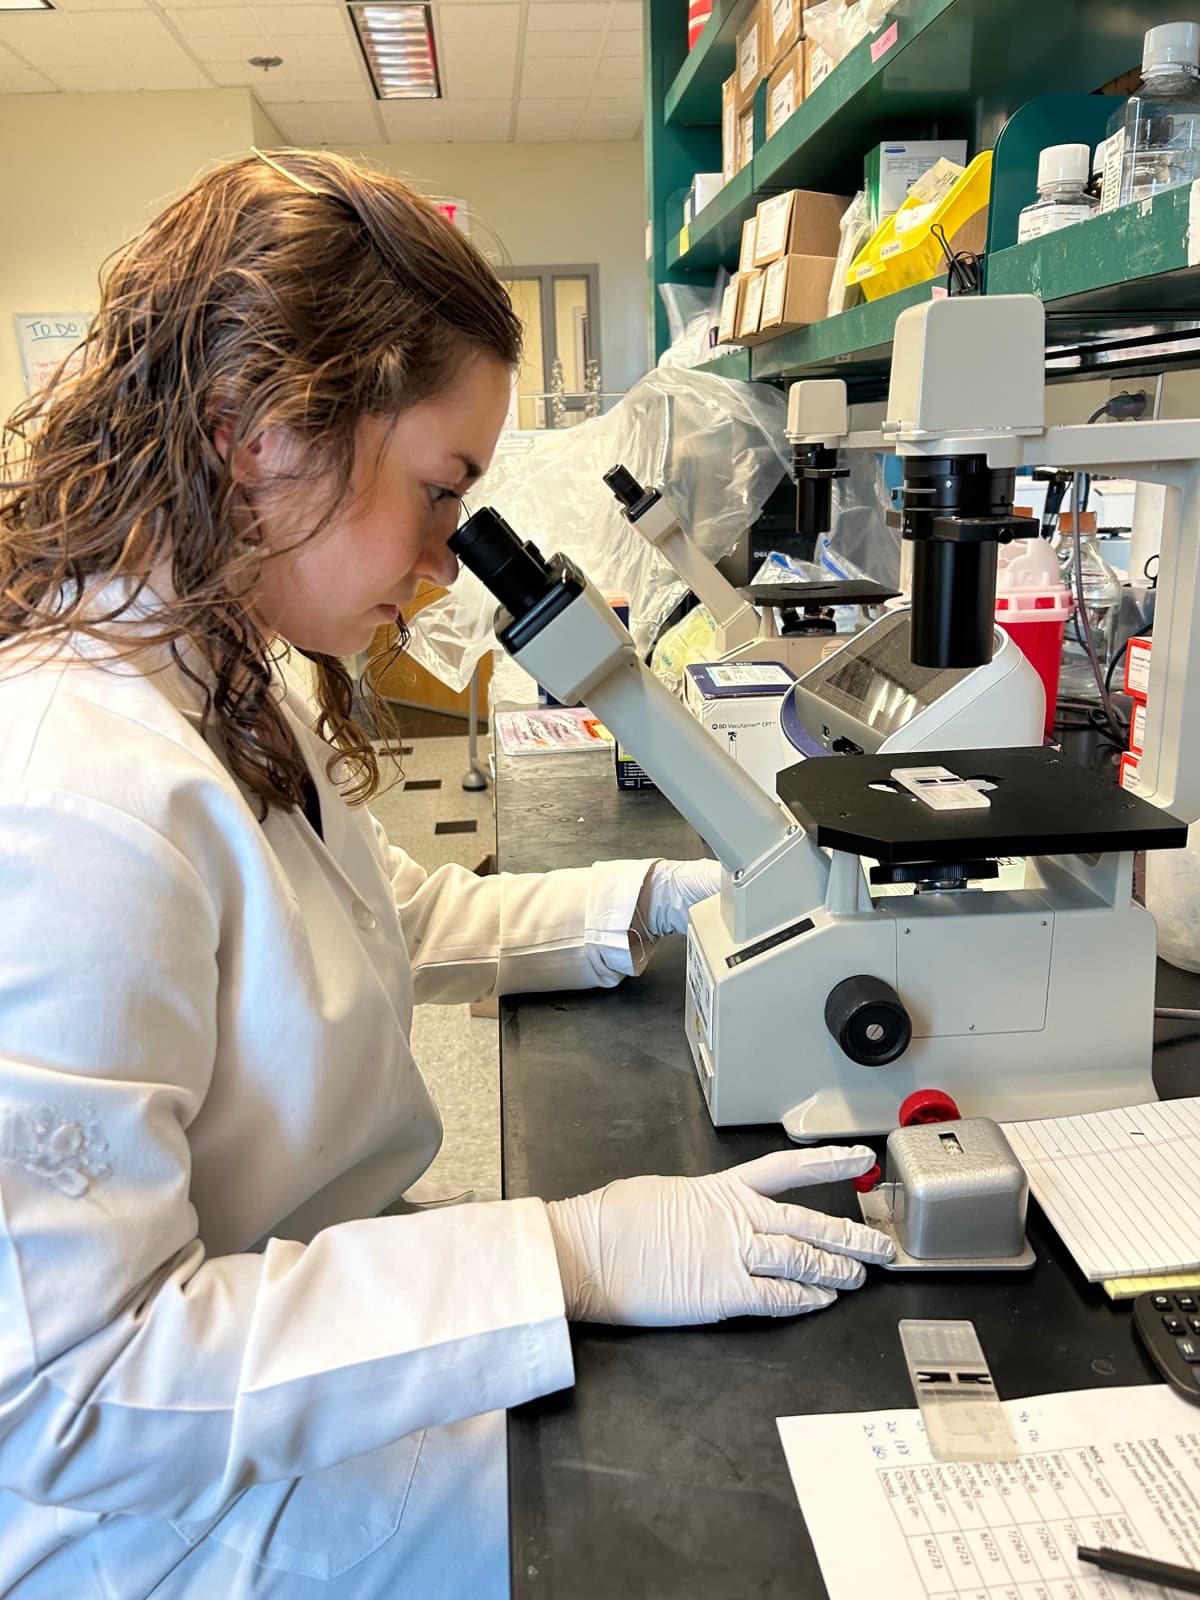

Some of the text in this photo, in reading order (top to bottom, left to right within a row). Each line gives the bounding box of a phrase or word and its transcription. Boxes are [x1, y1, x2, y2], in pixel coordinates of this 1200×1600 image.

[26, 320, 78, 337] TO DO
[1087, 1445, 1105, 1465] MICE
[924, 1538, 943, 1570] 8/2/23
[952, 1535, 972, 1566] 8/2/23
[980, 1532, 1000, 1562] 8/2/23
